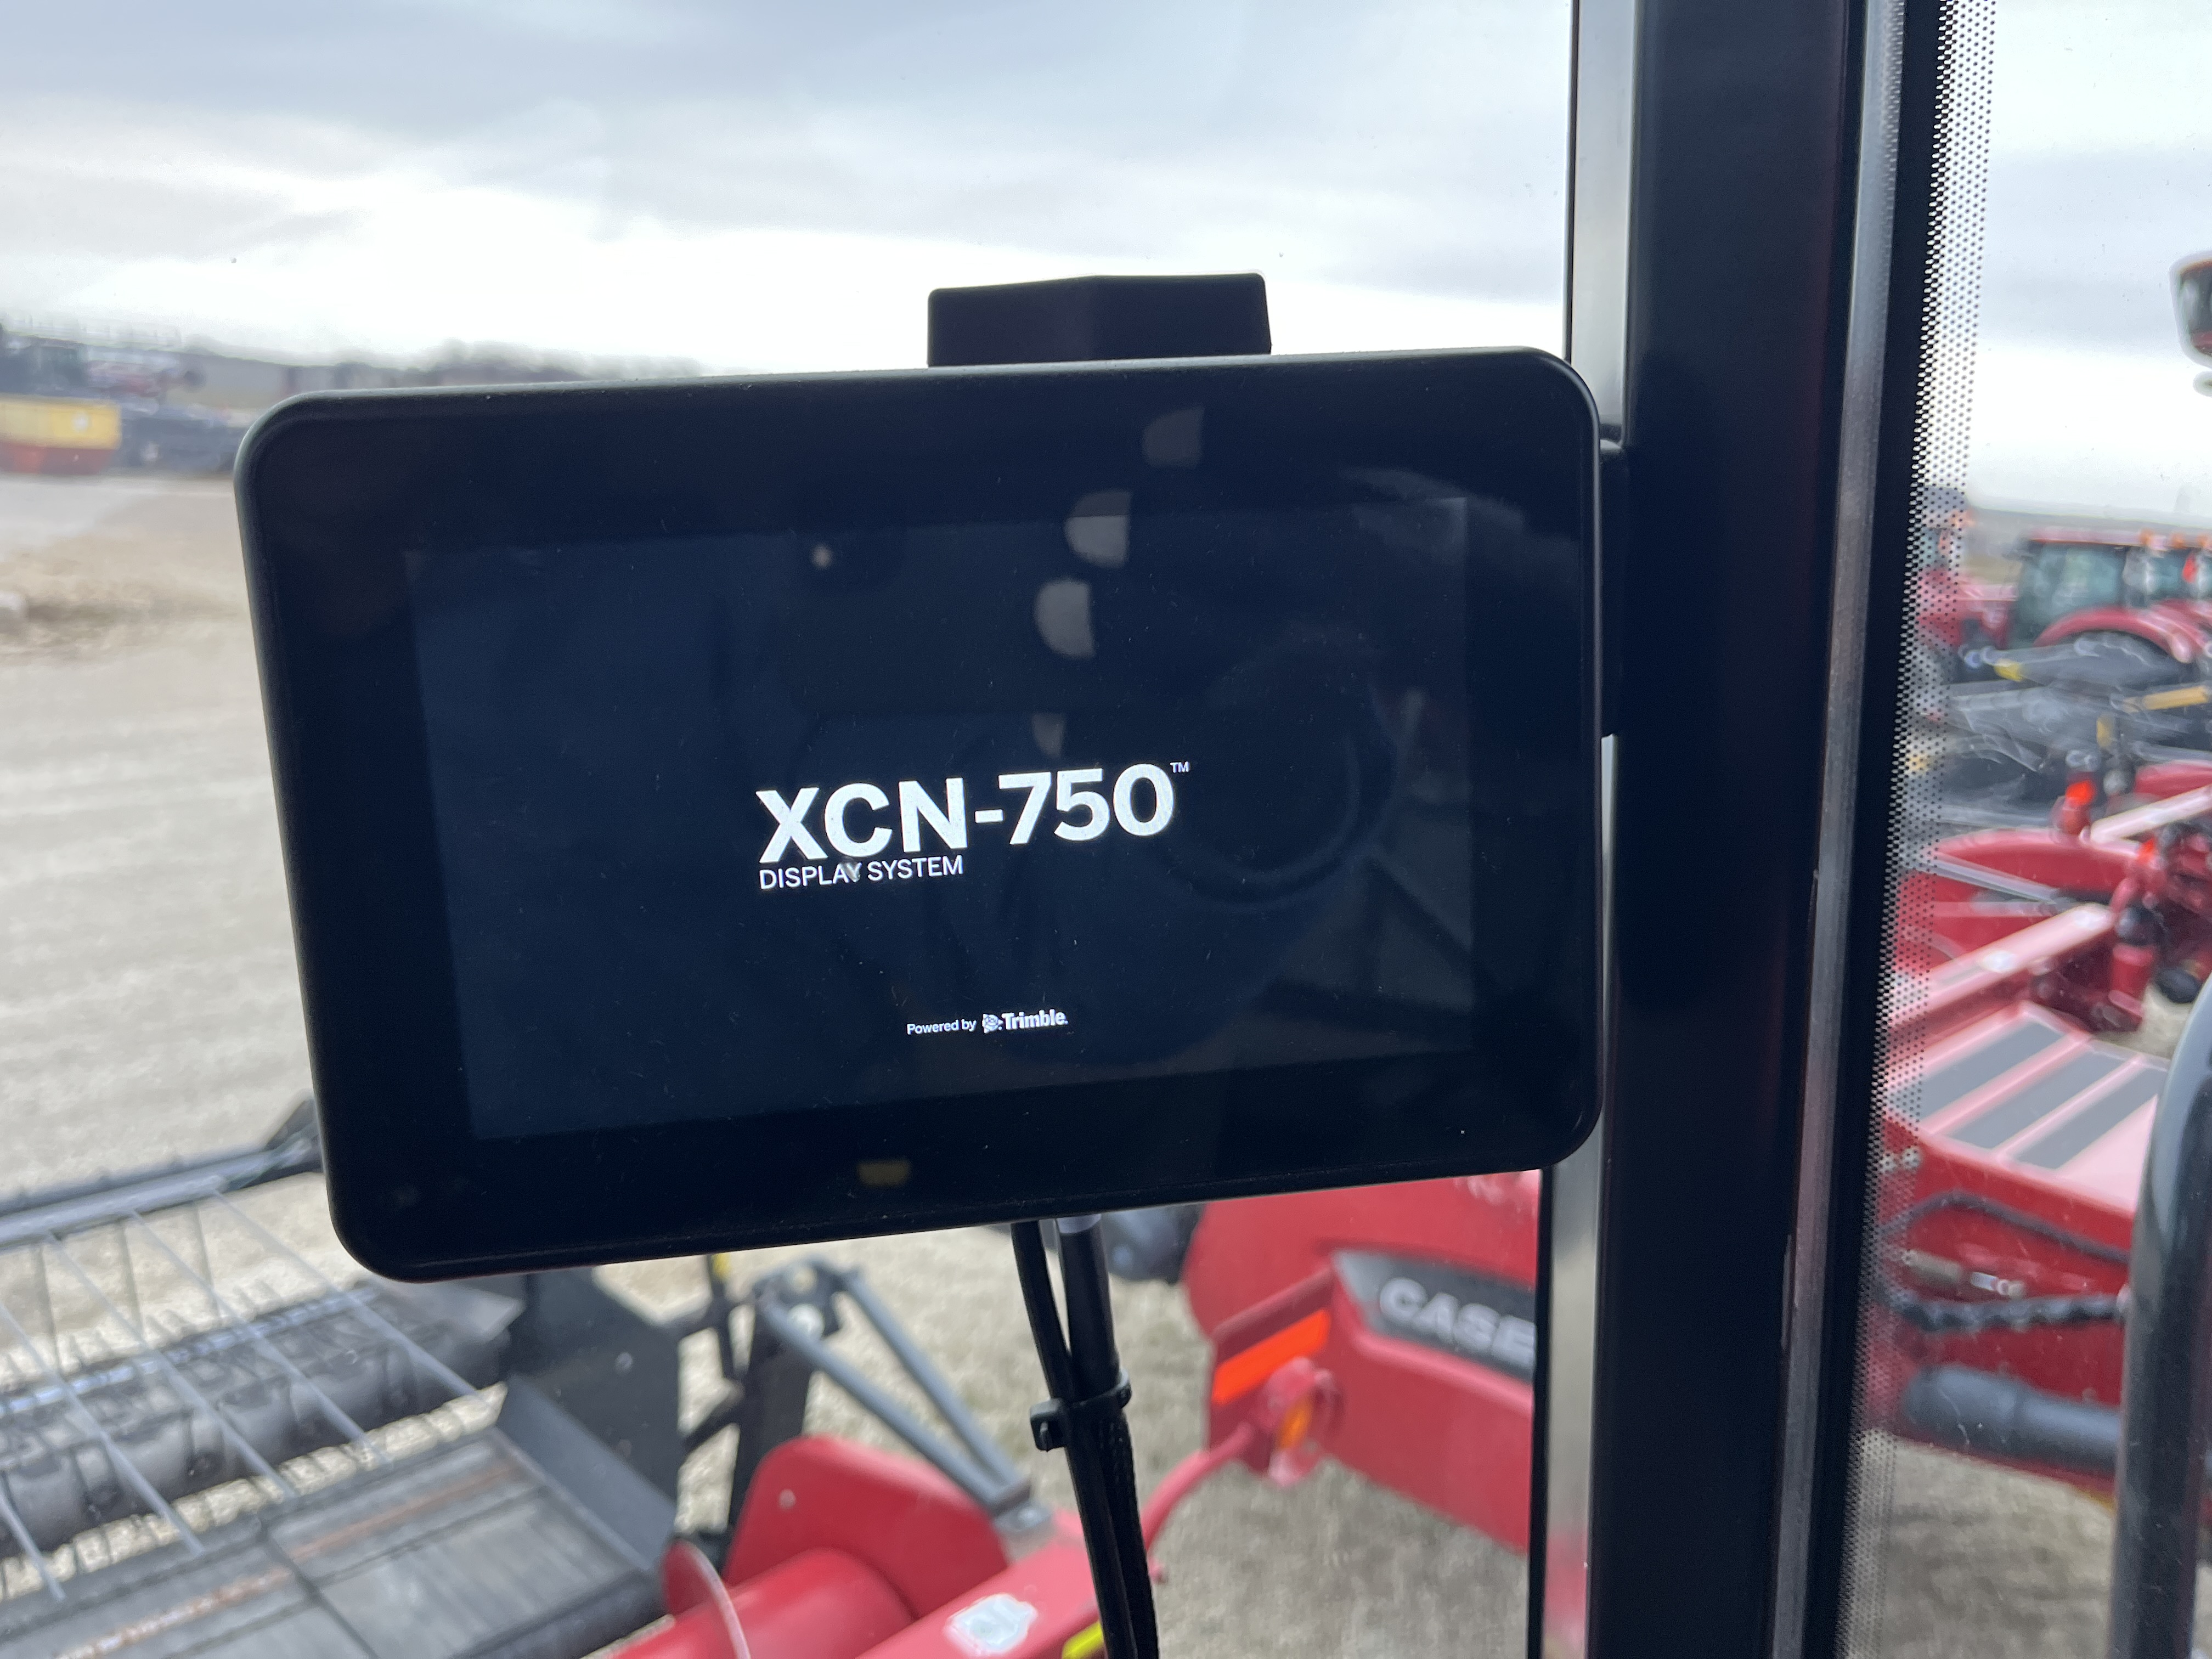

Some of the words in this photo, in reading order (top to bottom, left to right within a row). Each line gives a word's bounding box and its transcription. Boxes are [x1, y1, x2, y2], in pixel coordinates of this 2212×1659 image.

[759, 861, 862, 889] DISPLAY
[867, 855, 964, 882] SYSTEM
[906, 1019, 960, 1035] Powered
[961, 1019, 977, 1032] by
[1380, 1277, 1536, 1369] CASE
